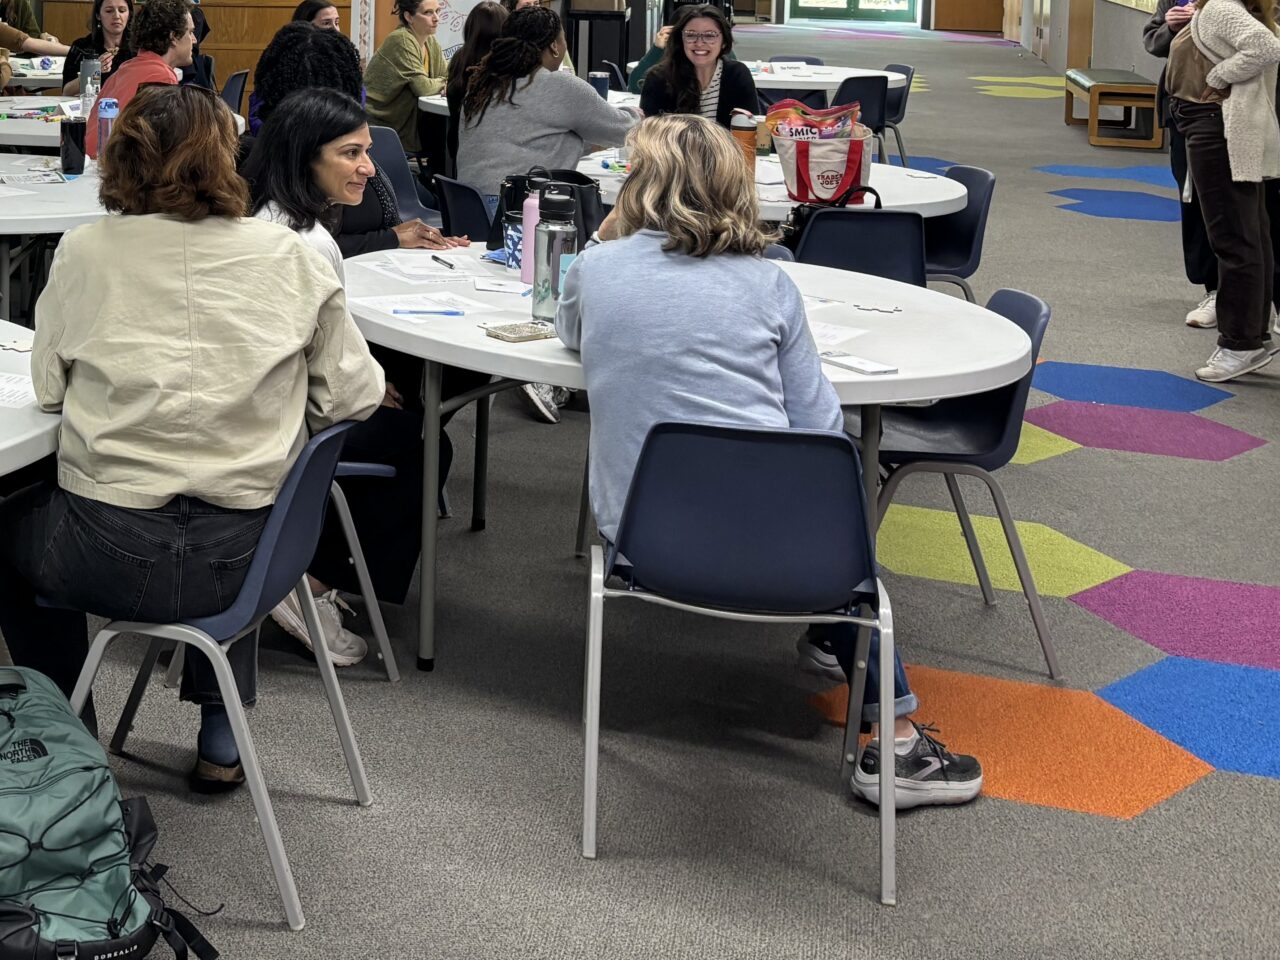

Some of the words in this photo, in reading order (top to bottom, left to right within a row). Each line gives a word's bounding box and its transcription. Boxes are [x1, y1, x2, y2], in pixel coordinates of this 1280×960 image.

[11, 739, 29, 750] THE
[0, 746, 31, 761] NORTH
[10, 754, 34, 764] FACE
